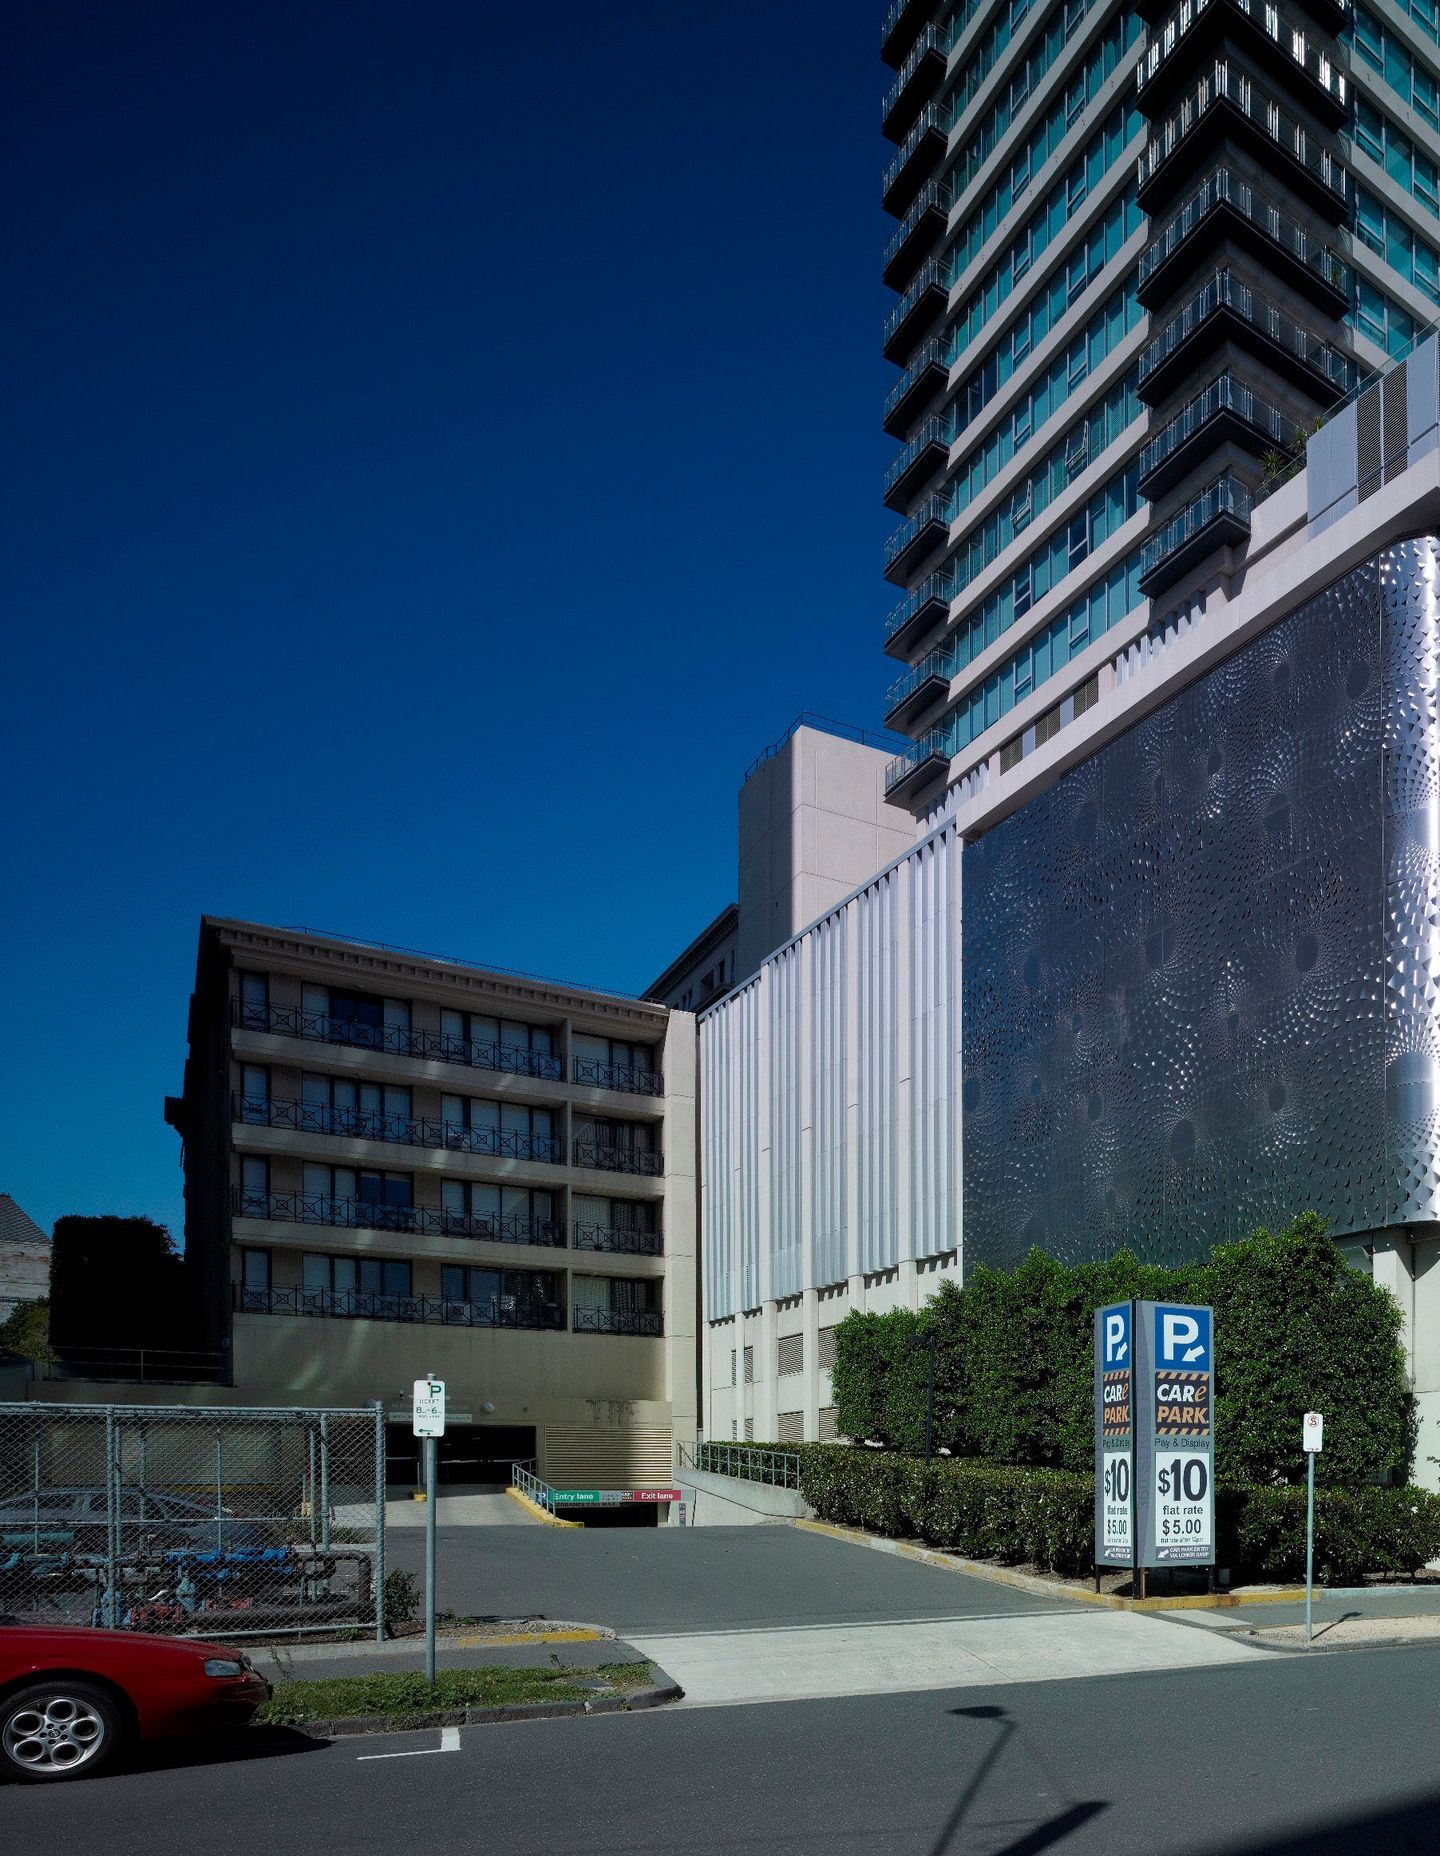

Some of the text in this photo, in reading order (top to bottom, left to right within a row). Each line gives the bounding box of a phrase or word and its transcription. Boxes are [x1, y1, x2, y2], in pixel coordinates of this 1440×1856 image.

[1106, 1314, 1125, 1361] P
[1163, 1314, 1199, 1360] P
[430, 1385, 442, 1398] P
[1154, 1438, 1210, 1449] Pay & Display
[1104, 1458, 1129, 1502] $10
[1157, 1458, 1208, 1502] $10
[554, 1493, 575, 1501] Entry
[641, 1492, 674, 1500] Exit lane
[1162, 1505, 1204, 1515] flat rate
